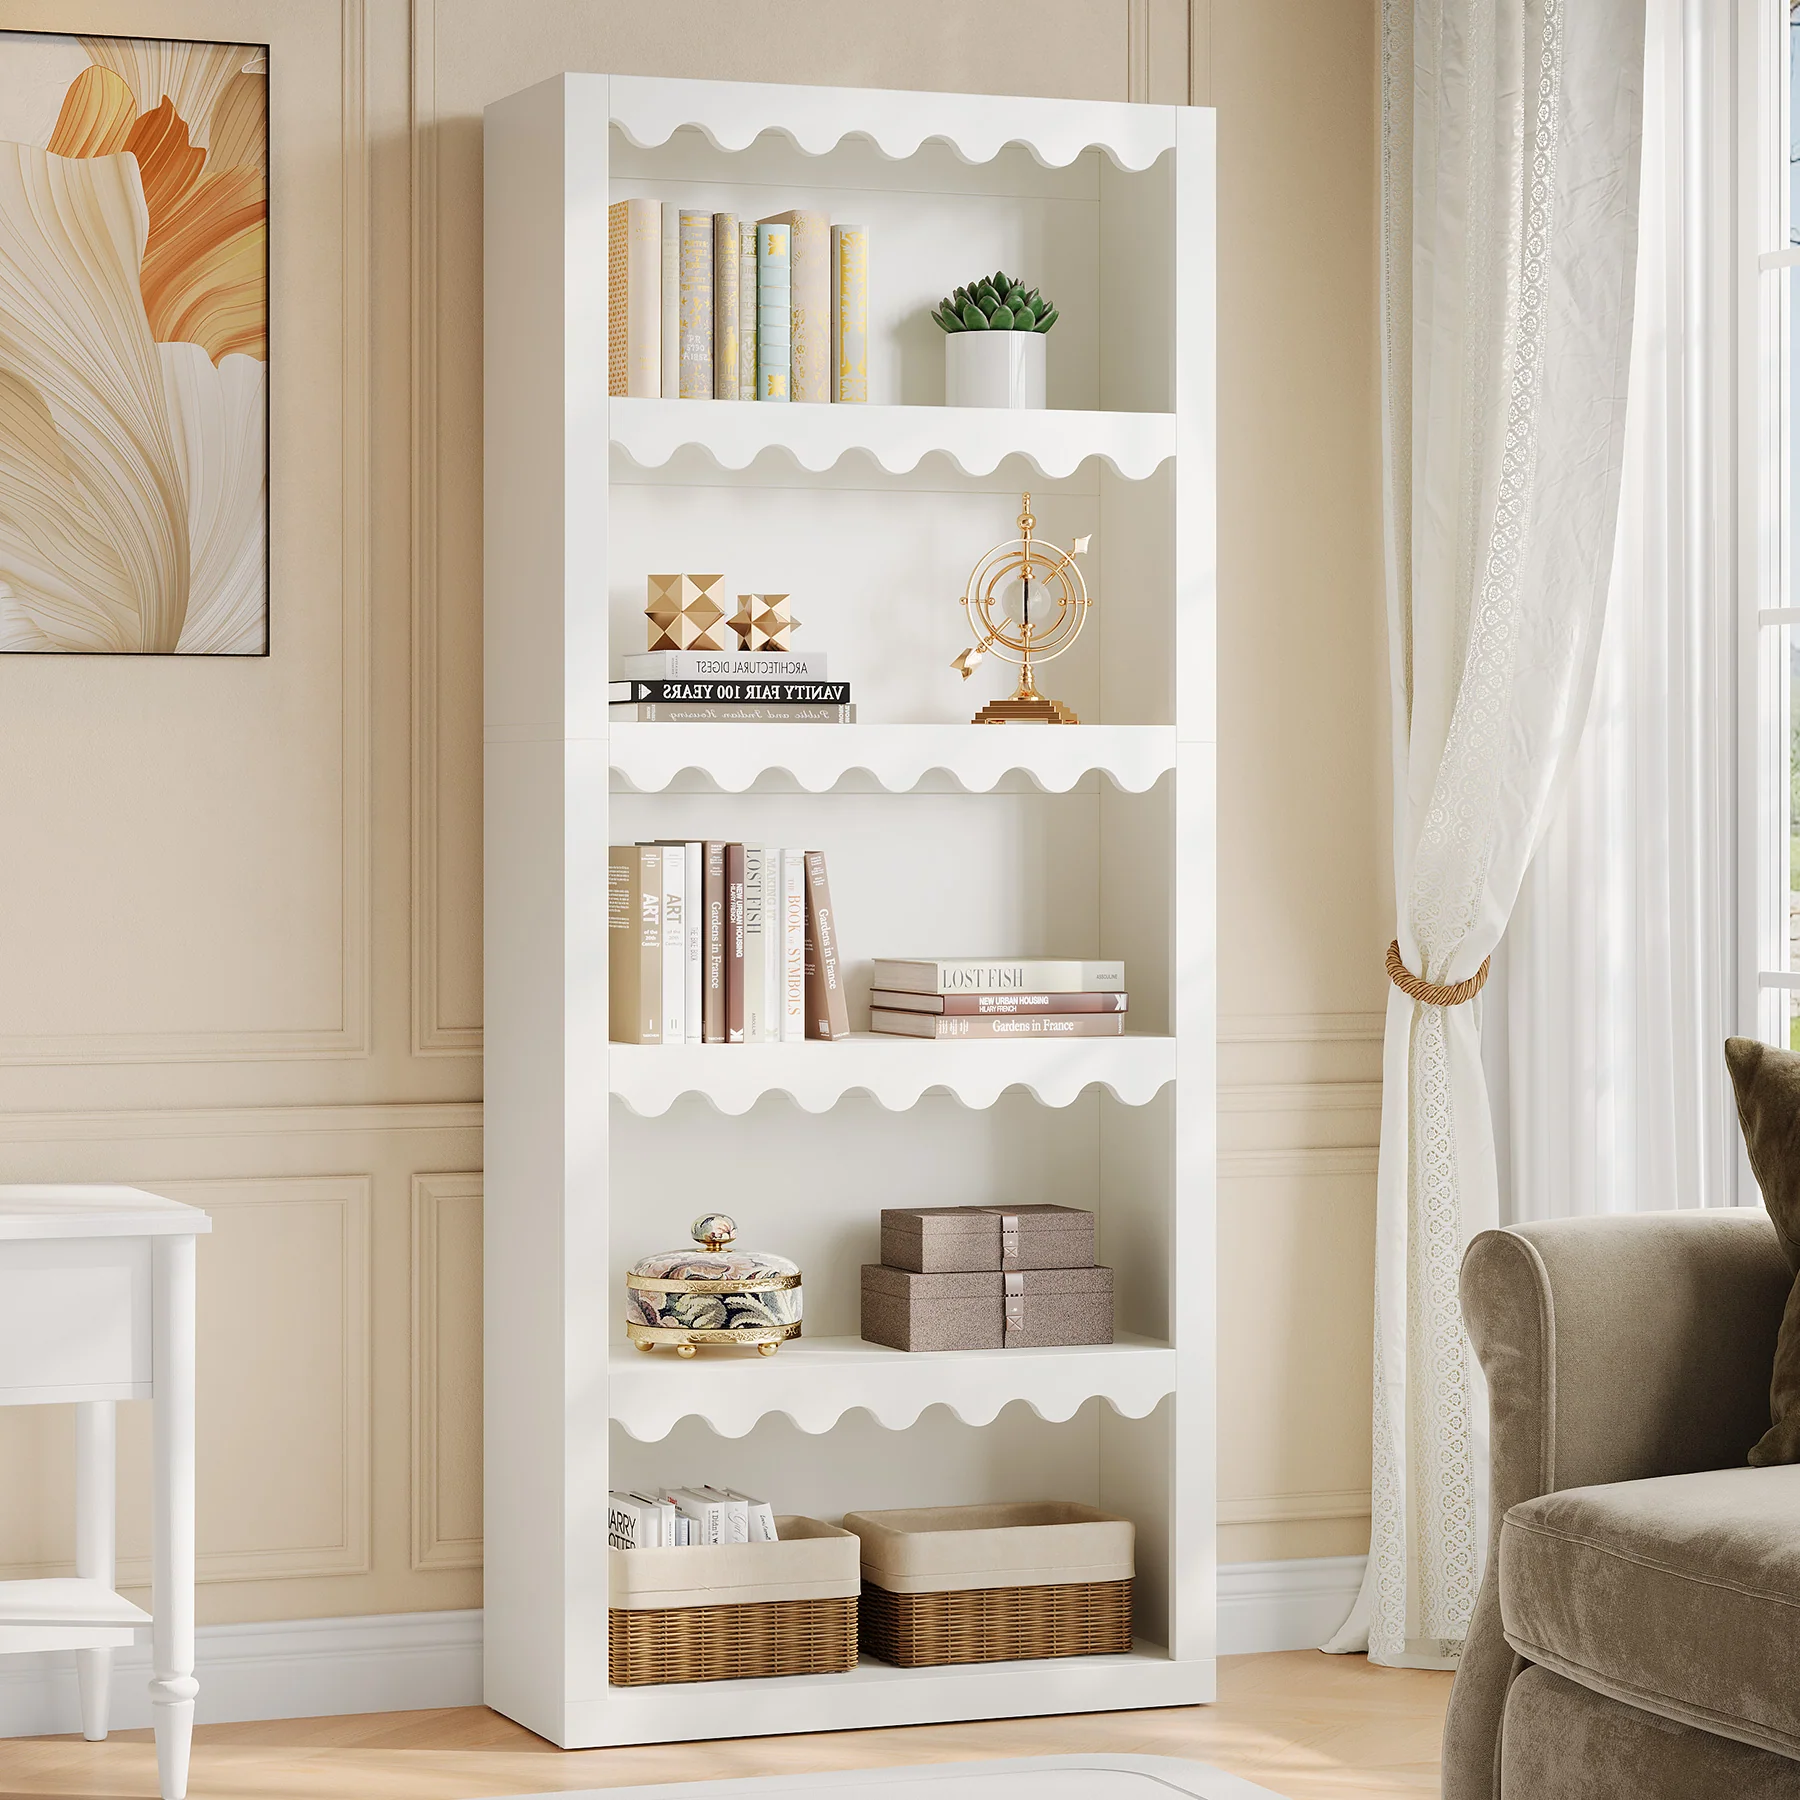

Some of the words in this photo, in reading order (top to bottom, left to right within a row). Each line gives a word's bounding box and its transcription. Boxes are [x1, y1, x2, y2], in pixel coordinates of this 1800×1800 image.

[686, 334, 701, 344] PR
[746, 849, 762, 892] LOST
[766, 857, 776, 906] MAKING
[735, 883, 744, 899] NEW
[643, 893, 659, 925] ART
[666, 893, 682, 925] ART
[711, 901, 722, 942] Gardens
[735, 900, 744, 925] URBAN
[746, 897, 762, 933] FISH
[787, 895, 801, 933] BOOK
[735, 926, 744, 957] HOUSING
[818, 908, 831, 947] Gardens
[711, 944, 722, 954] in
[824, 946, 835, 957] in
[711, 956, 722, 989] France
[787, 948, 801, 1016] SYMBOLS
[825, 958, 837, 990] France
[943, 968, 984, 989] LOST
[988, 968, 1024, 988] FISH
[979, 996, 995, 1006] NEW
[995, 996, 1018, 1005] URBAN
[1019, 996, 1049, 1005] HOUSING
[979, 1005, 996, 1013] HILARY
[996, 1005, 1017, 1013] FRENCH
[992, 1019, 1030, 1033] Gardens
[1031, 1019, 1041, 1032] in
[1043, 1018, 1074, 1032] France
